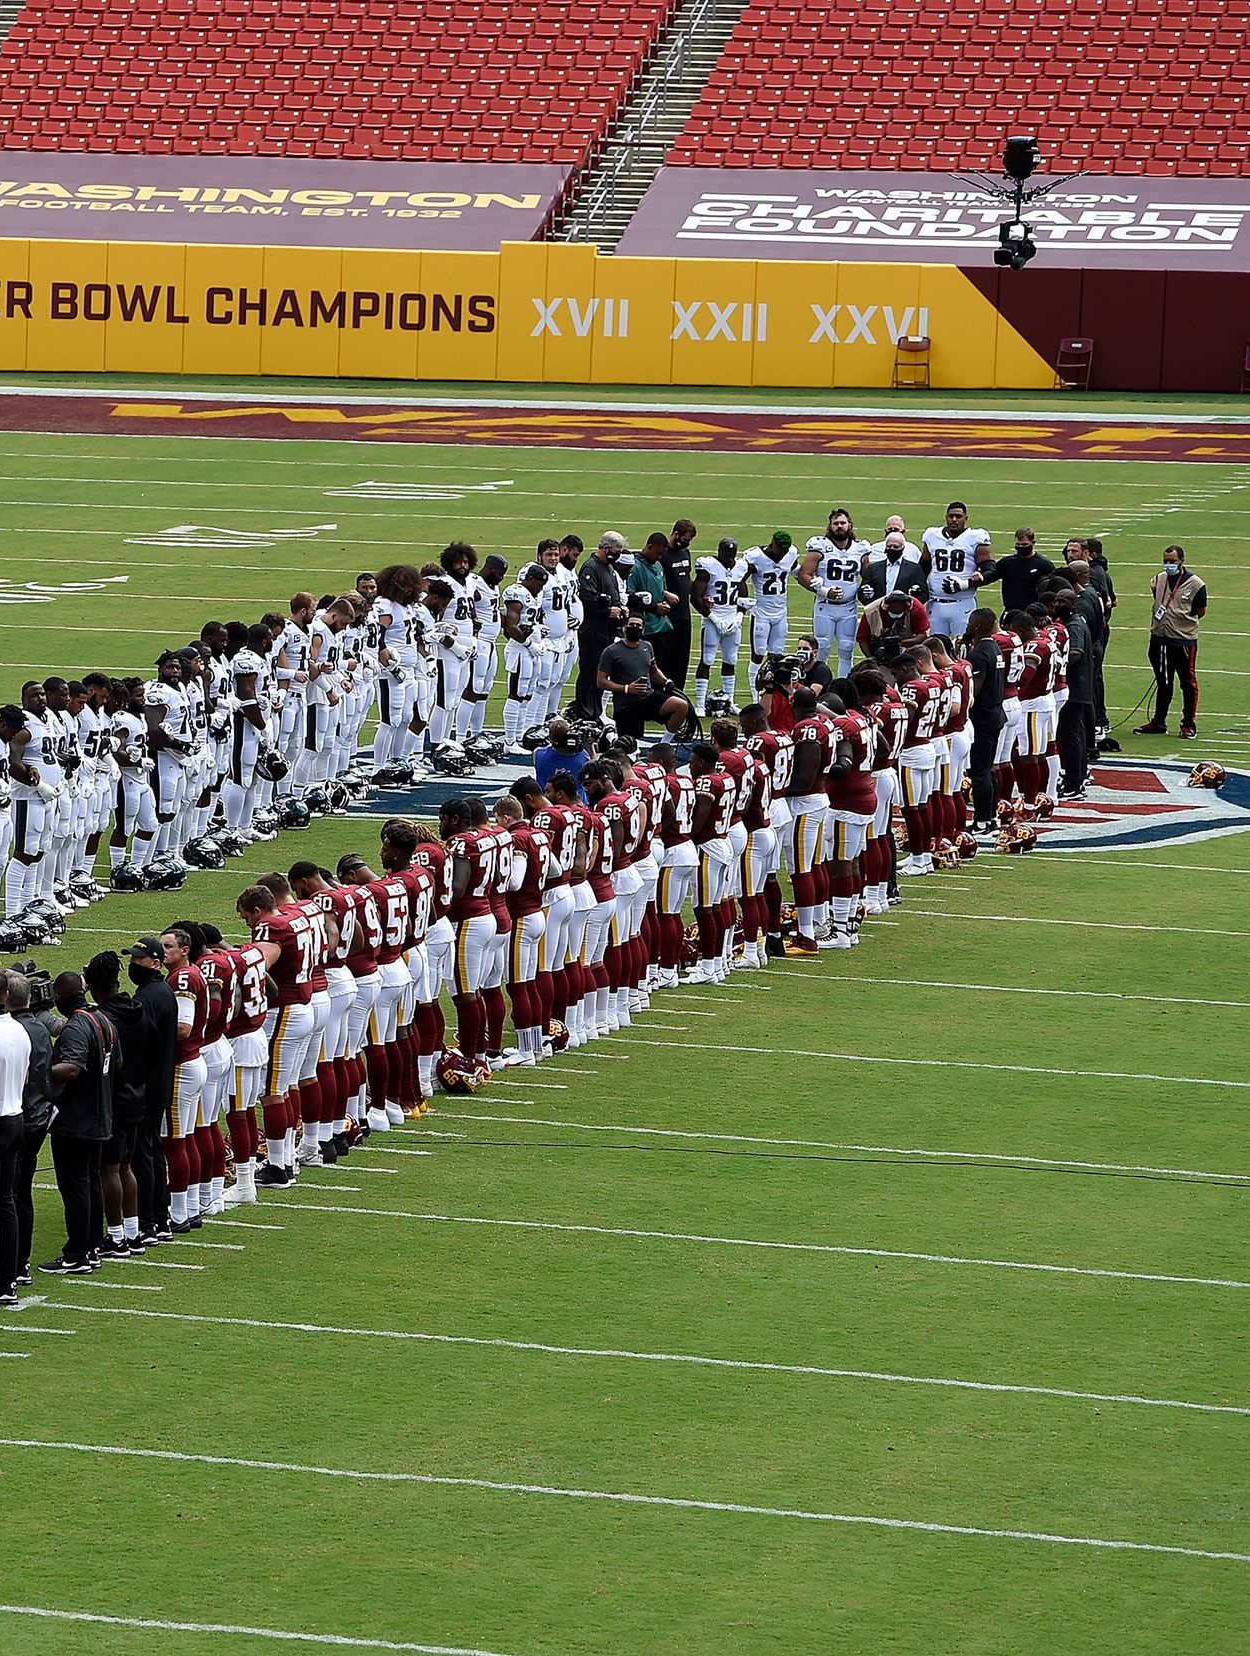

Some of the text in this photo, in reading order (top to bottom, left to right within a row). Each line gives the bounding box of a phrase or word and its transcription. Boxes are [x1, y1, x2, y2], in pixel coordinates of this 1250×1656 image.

[814, 188, 1139, 203] WASHINTON
[846, 198, 950, 207] FOOTBALL
[183, 204, 288, 217] TEAM,
[301, 207, 369, 217] EST.
[381, 209, 463, 219] 1932
[690, 201, 1246, 228] CHARITABLE
[51, 281, 190, 323] BOWL
[205, 287, 495, 333] CHAMPIONS
[530, 297, 629, 337] XVII
[669, 301, 767, 342] XXII
[807, 303, 928, 345] XXVI
[935, 549, 966, 573] 68
[827, 559, 858, 583] 62
[762, 571, 788, 596] 21
[713, 581, 739, 606] 32
[1025, 643, 1038, 653] 17
[902, 688, 917, 700] 25
[801, 728, 817, 740] 78
[41, 736, 57, 765] 9
[85, 730, 101, 758] 5
[747, 738, 763, 751] 87
[1205, 767, 1217, 779] 26
[695, 779, 711, 791] 32
[604, 806, 621, 820] 96
[533, 815, 551, 829] 82
[625, 809, 641, 853] 9
[1017, 829, 1030, 840] 83
[450, 841, 466, 855] 74
[496, 846, 515, 893] 9
[440, 856, 454, 906] 9
[255, 926, 270, 941] 71
[336, 908, 357, 959] 9
[201, 963, 216, 978] 31
[177, 975, 189, 990] 5
